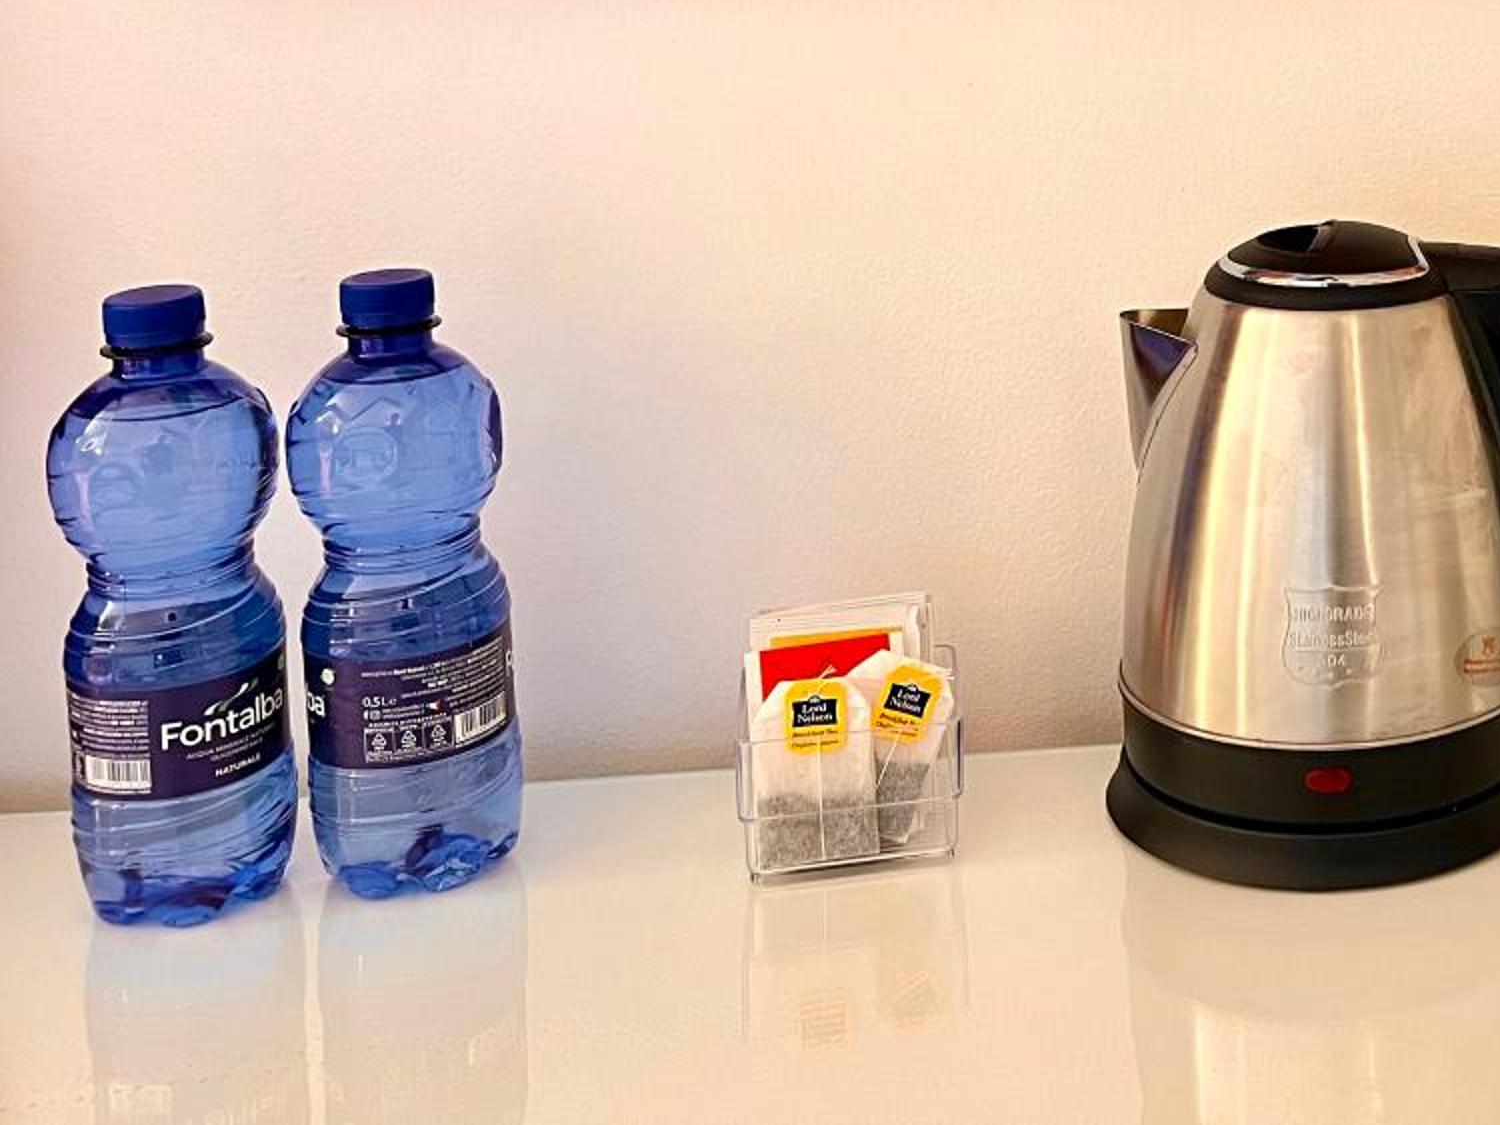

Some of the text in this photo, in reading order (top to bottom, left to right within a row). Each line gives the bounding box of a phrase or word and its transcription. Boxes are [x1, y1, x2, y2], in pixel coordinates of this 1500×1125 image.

[796, 712, 834, 724] Nelson
[802, 702, 827, 715] Lord
[161, 687, 283, 751] Fontalba
[215, 752, 261, 777] NATURALE
